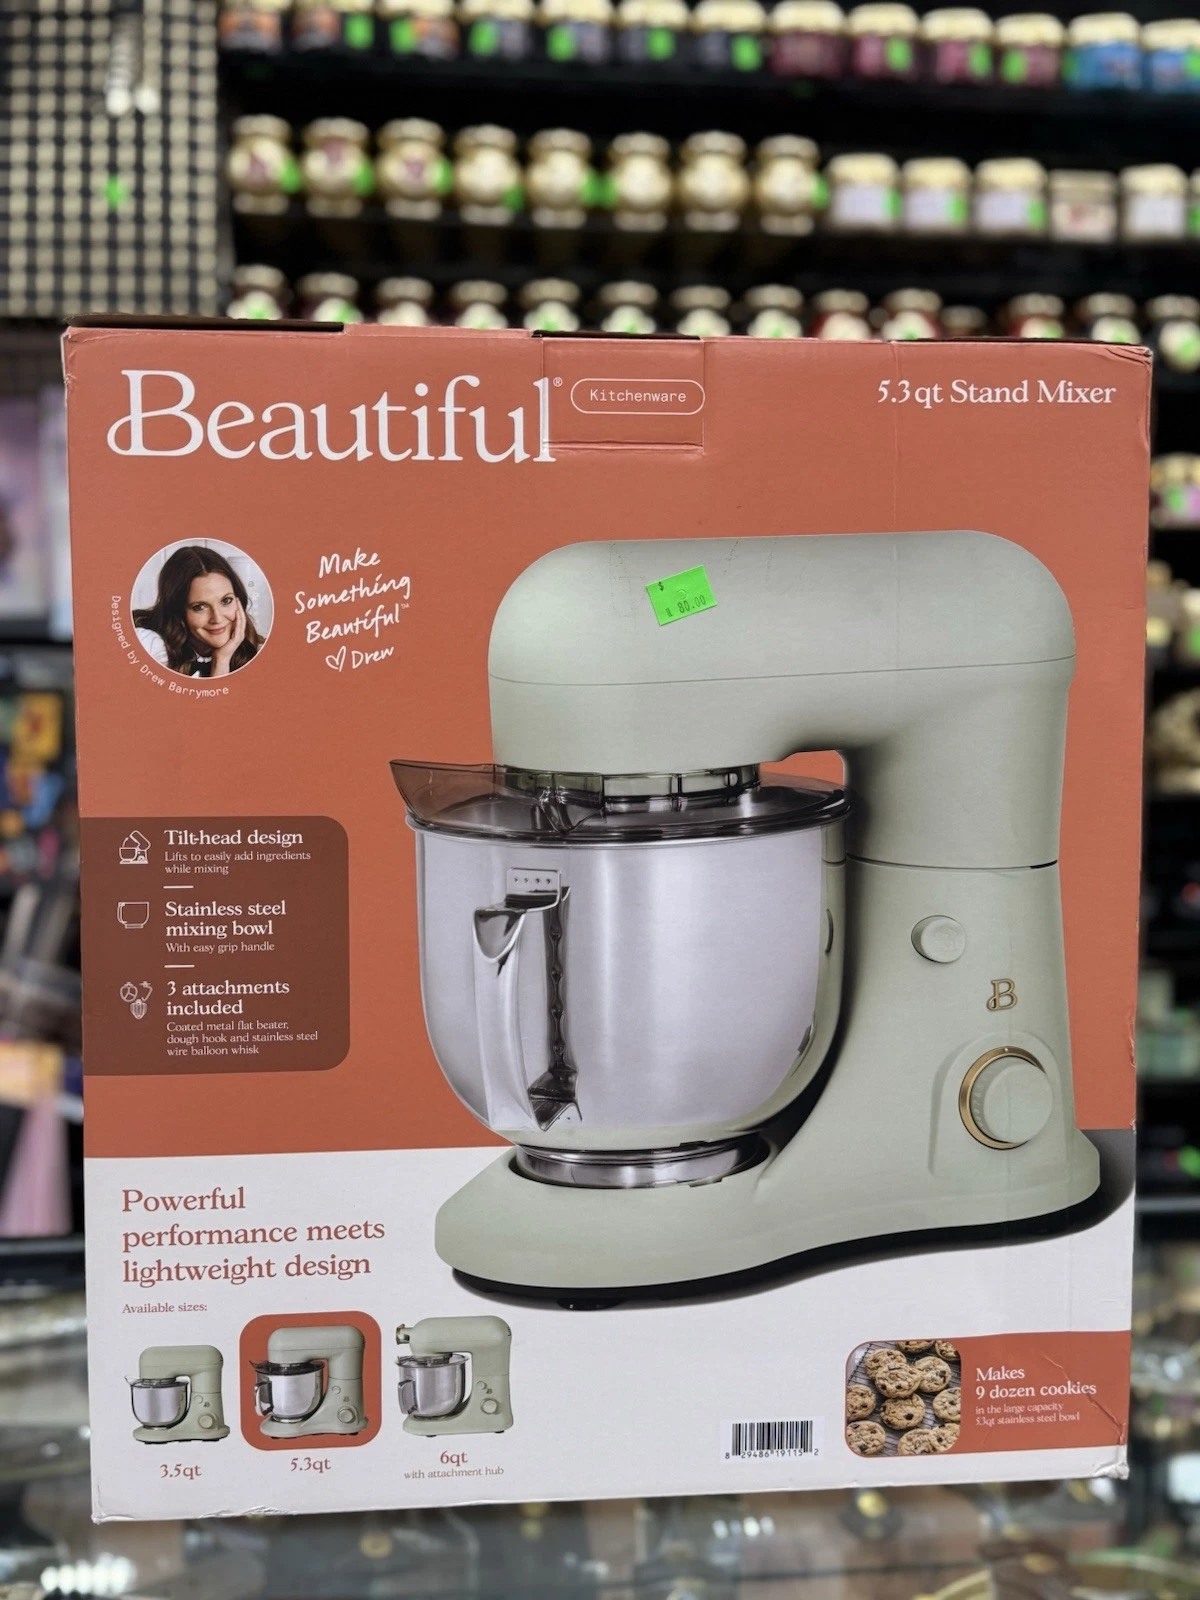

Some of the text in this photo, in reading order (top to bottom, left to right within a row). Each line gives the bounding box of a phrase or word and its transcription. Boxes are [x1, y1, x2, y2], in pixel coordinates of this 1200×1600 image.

[590, 388, 687, 403] Kitchenware
[950, 379, 1029, 403] Stand
[1037, 380, 1117, 404] Mixer
[318, 547, 381, 579] Make
[294, 573, 411, 614] Something
[677, 594, 706, 613] 80.00
[111, 595, 230, 699] Designed by Drew Barrymore
[351, 646, 395, 669] Drew
[164, 829, 304, 848] Tilt-head design
[164, 850, 312, 863] Lifts to easily add ingredients
[165, 864, 229, 876] while mixing
[165, 900, 287, 917] Stainless steel
[165, 920, 274, 940] mixing bowl
[166, 942, 275, 955] With easy grip handle
[166, 981, 290, 996] 3 attachments
[166, 999, 244, 1016] included
[166, 1021, 204, 1032] Coated
[206, 1020, 235, 1031] metal
[237, 1020, 254, 1031] flat
[166, 1031, 318, 1046] dough hook and stainless steel
[166, 1044, 260, 1056] wire balloon whisk
[122, 1186, 247, 1212] Powerful
[122, 1219, 386, 1253] performance meets
[122, 1254, 372, 1288] lightweight design
[122, 1302, 208, 1314] Available sizes:
[976, 1366, 1025, 1381] Makes
[976, 1380, 1097, 1400] 9 dozen cookies
[976, 1402, 1064, 1415] in the large capacity
[997, 1414, 1034, 1425] stainless
[1036, 1413, 1057, 1423] steel
[1058, 1412, 1081, 1421] bowl
[440, 1450, 469, 1467] 6qt
[814, 1448, 819, 1456] 2
[159, 1463, 203, 1480] 3.5qt
[290, 1457, 332, 1474] 5.3qt
[404, 1466, 505, 1480] with attachment hub
